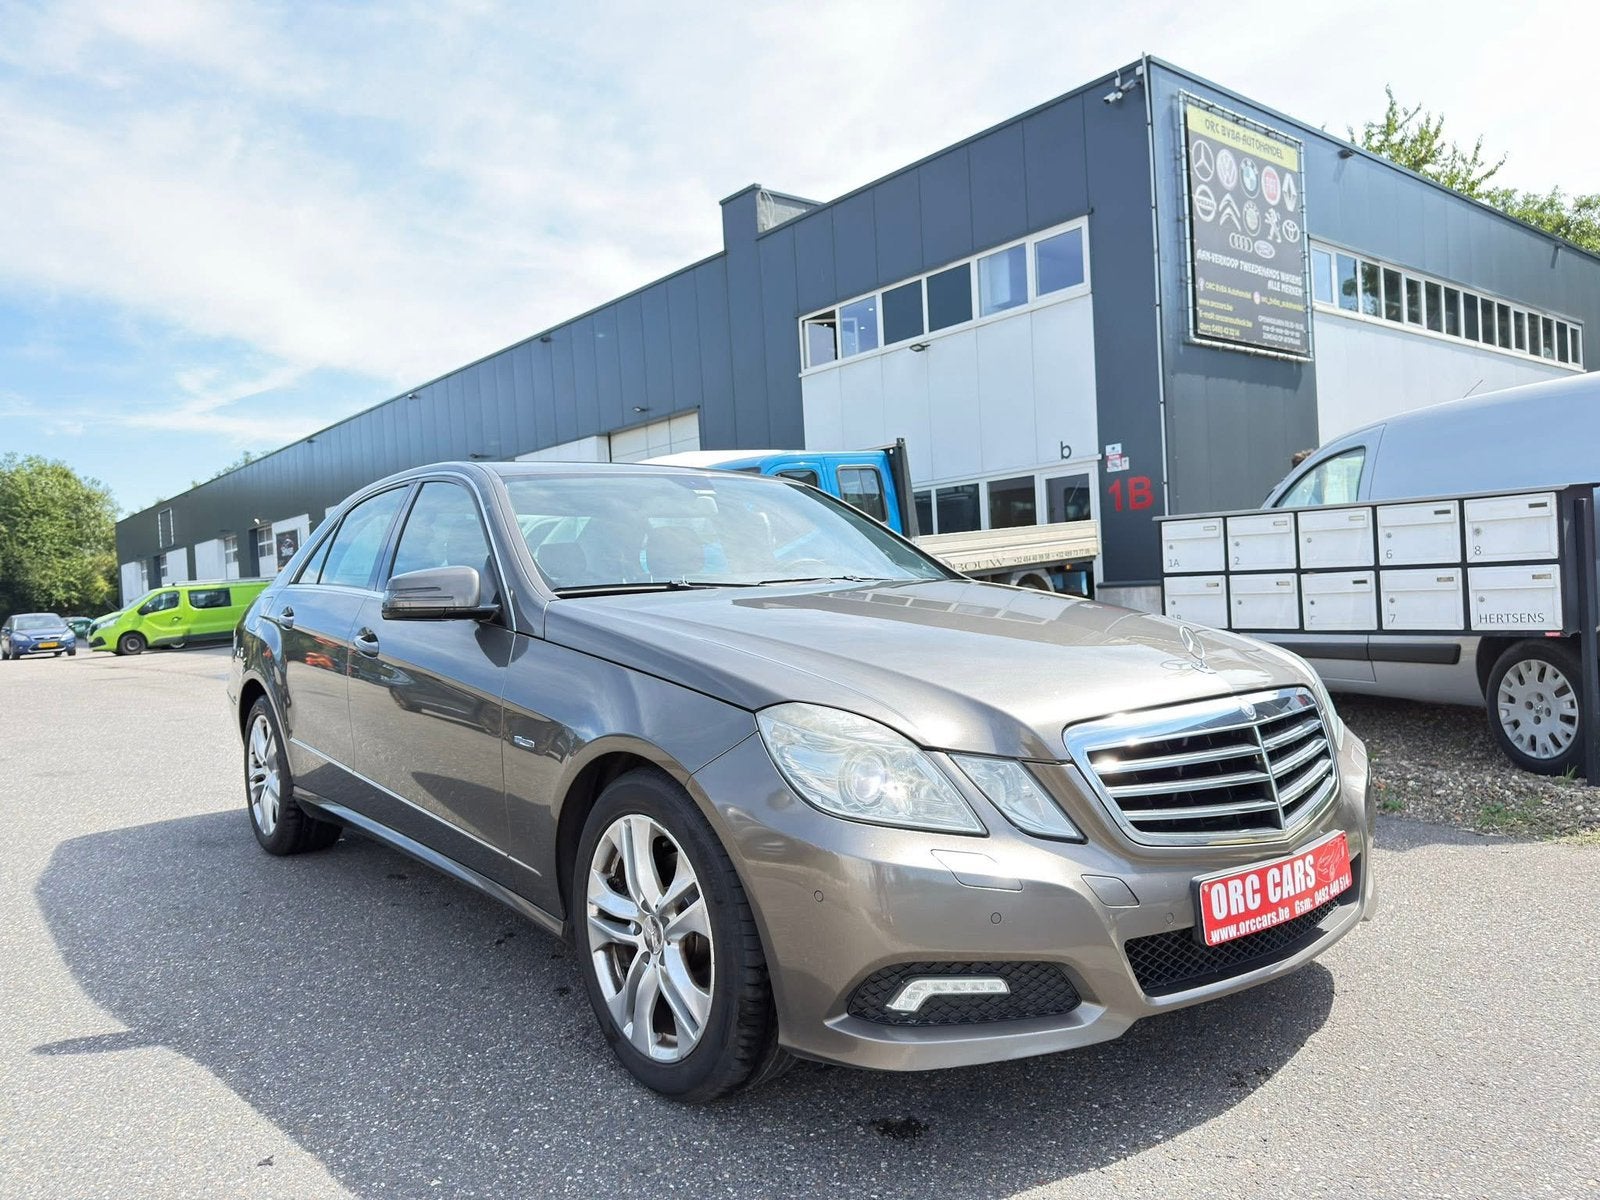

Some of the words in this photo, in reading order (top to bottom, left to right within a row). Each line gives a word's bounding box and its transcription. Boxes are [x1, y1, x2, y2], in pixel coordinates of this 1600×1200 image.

[1204, 118, 1220, 133] ORC
[1060, 440, 1072, 460] b
[1108, 475, 1154, 513] 1B
[1385, 549, 1393, 560] 6
[1474, 545, 1482, 556] 8
[949, 557, 1006, 571] BOUW
[1168, 558, 1180, 568] 1A
[1234, 556, 1240, 566] 2
[1390, 613, 1397, 623] 7
[1479, 612, 1545, 624] HERTSENS
[1210, 874, 1261, 920] ORC
[1266, 854, 1316, 903] CARS
[1211, 905, 1290, 943] www.orccars.be
